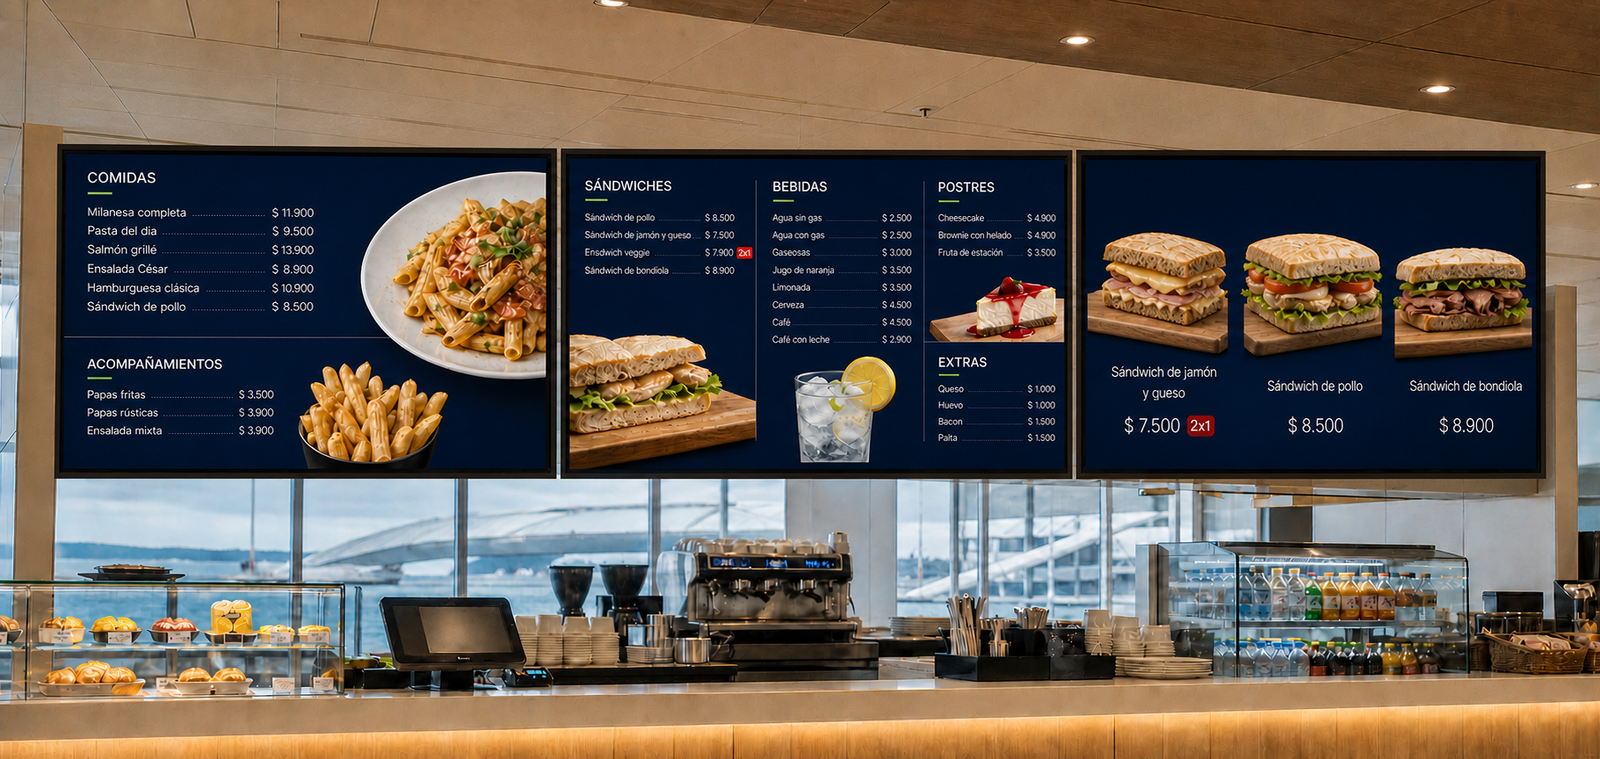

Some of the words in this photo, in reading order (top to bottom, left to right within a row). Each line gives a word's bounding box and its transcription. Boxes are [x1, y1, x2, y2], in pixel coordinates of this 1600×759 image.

[87, 171, 156, 184] COMIDAS
[585, 177, 672, 191] SÁNDWICHES
[773, 181, 827, 192] BEBIDAS
[938, 181, 995, 193] POSTRES
[88, 207, 134, 217] Milanesa
[137, 208, 186, 219] completa
[272, 207, 279, 218] $
[282, 208, 314, 218] 11.900
[585, 213, 623, 222] Sándwich
[624, 213, 635, 221] de
[636, 214, 655, 223] pollo
[705, 213, 711, 222] $
[712, 213, 735, 222] 8.500
[772, 214, 793, 224] Agua
[795, 214, 806, 222] sin
[808, 215, 822, 224] gas
[882, 213, 888, 222] $
[889, 214, 912, 222] 2.500
[938, 213, 985, 222] Cheesecake
[1027, 213, 1033, 222] $
[1034, 214, 1056, 222] 4.900
[88, 225, 118, 236] Pasta
[121, 226, 137, 236] del
[272, 225, 279, 237] $
[283, 226, 314, 236] 9.500
[585, 230, 623, 239] Sándwich
[624, 231, 635, 239] de
[636, 231, 660, 241] jamón
[661, 233, 666, 241] y
[705, 230, 711, 240] $
[713, 231, 735, 239] 7.500
[772, 231, 793, 241] Agua
[810, 232, 825, 241] gas
[882, 230, 888, 240] $
[889, 231, 912, 239] 2.500
[938, 231, 969, 239] Brownie
[986, 231, 1012, 239] helado
[1027, 231, 1033, 240] $
[1034, 231, 1056, 240] 4.900
[87, 244, 128, 254] Salmón
[131, 244, 157, 257] grillé
[272, 244, 279, 255] $
[281, 245, 314, 255] 13.900
[624, 249, 650, 259] veggie
[705, 248, 711, 257] $
[712, 248, 734, 257] 7.900
[738, 248, 751, 257] 2x1
[772, 248, 811, 257] Gaseosas
[882, 248, 888, 257] $
[889, 248, 912, 257] 3.000
[938, 248, 958, 257] Fruta
[959, 248, 970, 257] de
[971, 248, 1003, 257] estación
[1027, 248, 1033, 257] $
[1034, 248, 1056, 257] 3.500
[87, 263, 134, 274] Ensalada
[138, 263, 168, 274] César
[272, 264, 279, 275] $
[283, 264, 314, 274] 8.900
[585, 266, 623, 275] Sándwich
[624, 266, 635, 275] de
[636, 266, 669, 275] bondiola
[705, 266, 711, 275] $
[712, 266, 735, 275] 8.900
[772, 266, 792, 276] Jugo
[793, 266, 804, 274] de
[806, 266, 835, 276] naranja
[882, 265, 888, 275] $
[890, 266, 912, 274] 3.500
[87, 283, 161, 295] Hamburguesa
[164, 283, 200, 293] clásica
[272, 283, 279, 294] $
[281, 283, 314, 293] 10.900
[772, 283, 811, 292] Limonada
[882, 283, 888, 292] $
[889, 283, 912, 292] 3.500
[87, 301, 140, 312] Sándwich
[143, 302, 157, 312] de
[161, 302, 186, 314] pollo
[272, 301, 279, 312] $
[283, 301, 314, 311] 8.500
[772, 300, 804, 309] Cerveza
[882, 300, 888, 309] $
[889, 300, 912, 309] 4.500
[772, 318, 791, 327] Café
[882, 318, 888, 326] $
[889, 318, 912, 326] 4.500
[772, 335, 791, 344] Café
[809, 335, 830, 344] leche
[882, 335, 888, 344] $
[890, 335, 912, 344] 2.900
[87, 356, 222, 370] ACOMPAÑAMIENTOS
[938, 357, 987, 368] EXTRAS
[1111, 366, 1164, 378] Sándwich
[1167, 366, 1181, 378] de
[1183, 366, 1217, 380] jamón
[938, 384, 964, 393] Queso
[1027, 384, 1033, 393] $
[1035, 385, 1056, 393] 1.000
[1267, 380, 1318, 392] Sándwich
[1321, 380, 1335, 392] de
[1338, 380, 1363, 394] pollo
[1410, 380, 1460, 392] Sándwich
[1463, 380, 1476, 392] de
[1479, 380, 1522, 392] bondiola
[87, 390, 118, 401] Papas
[120, 390, 146, 399] fritas
[239, 389, 245, 399] $
[247, 389, 274, 399] 3.500
[1142, 390, 1149, 401] y
[938, 401, 964, 409] Huevo
[1027, 401, 1033, 410] $
[1035, 401, 1056, 409] 1.000
[87, 408, 117, 419] Papas
[120, 408, 158, 417] rústicas
[239, 407, 245, 417] $
[247, 408, 274, 417] 3.900
[938, 417, 963, 426] Bacon
[1028, 417, 1033, 426] $
[1035, 417, 1056, 426] 1.500
[1124, 416, 1134, 435] $
[1139, 417, 1180, 433] 7.500
[1190, 419, 1210, 432] 2x1
[1288, 416, 1297, 435] $
[1302, 417, 1344, 433] 8.500
[1439, 416, 1449, 434] $
[1453, 417, 1494, 433] 8.900
[87, 426, 132, 435] Ensalada
[135, 426, 162, 435] mixta
[239, 425, 245, 436] $
[247, 426, 274, 435] 3.900
[938, 433, 958, 442] Palta
[1027, 433, 1033, 442] $
[1035, 433, 1056, 442] 1.500
